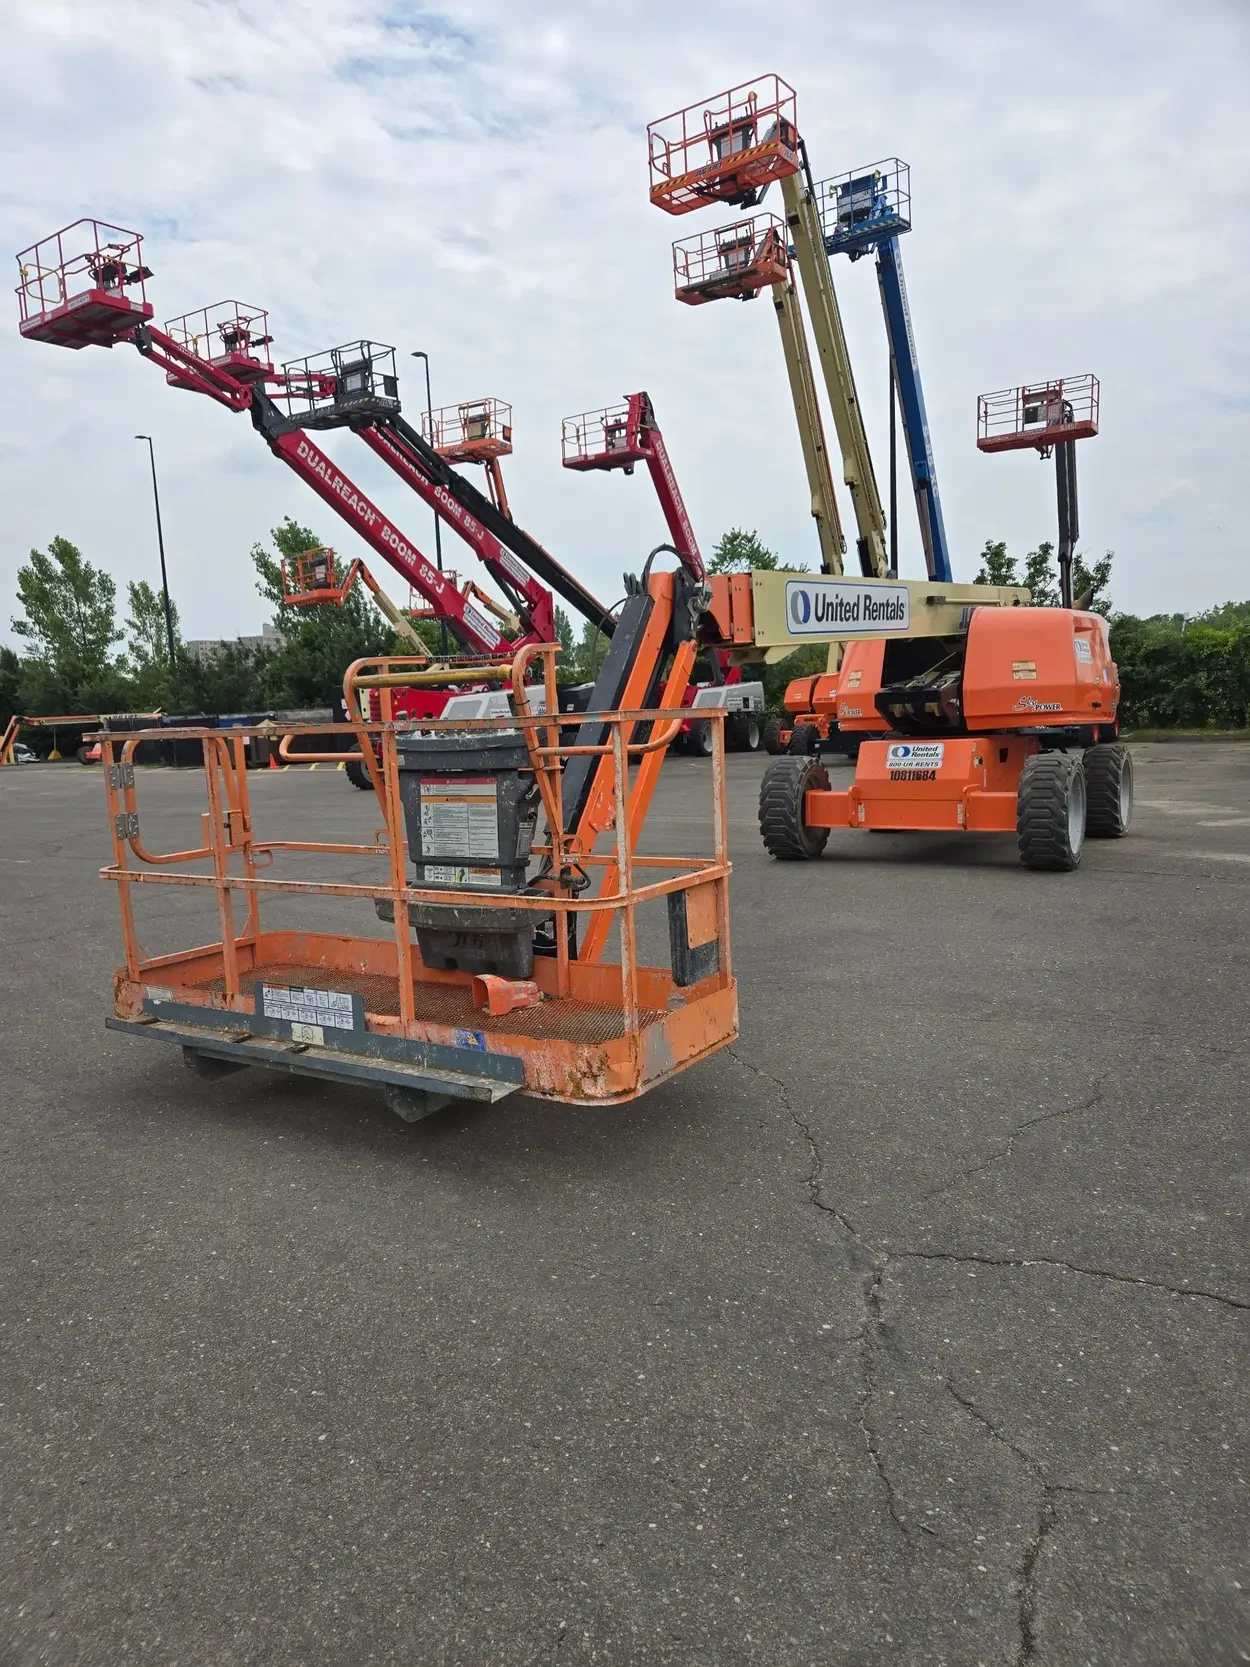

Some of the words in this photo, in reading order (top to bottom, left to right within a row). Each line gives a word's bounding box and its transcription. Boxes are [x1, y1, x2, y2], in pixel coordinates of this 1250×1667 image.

[434, 485, 462, 519] BOOM
[682, 520, 698, 556] BOOM
[380, 525, 417, 567] BOOM
[419, 564, 445, 594] 85-J
[814, 592, 860, 623] United
[863, 594, 905, 623] Rentals
